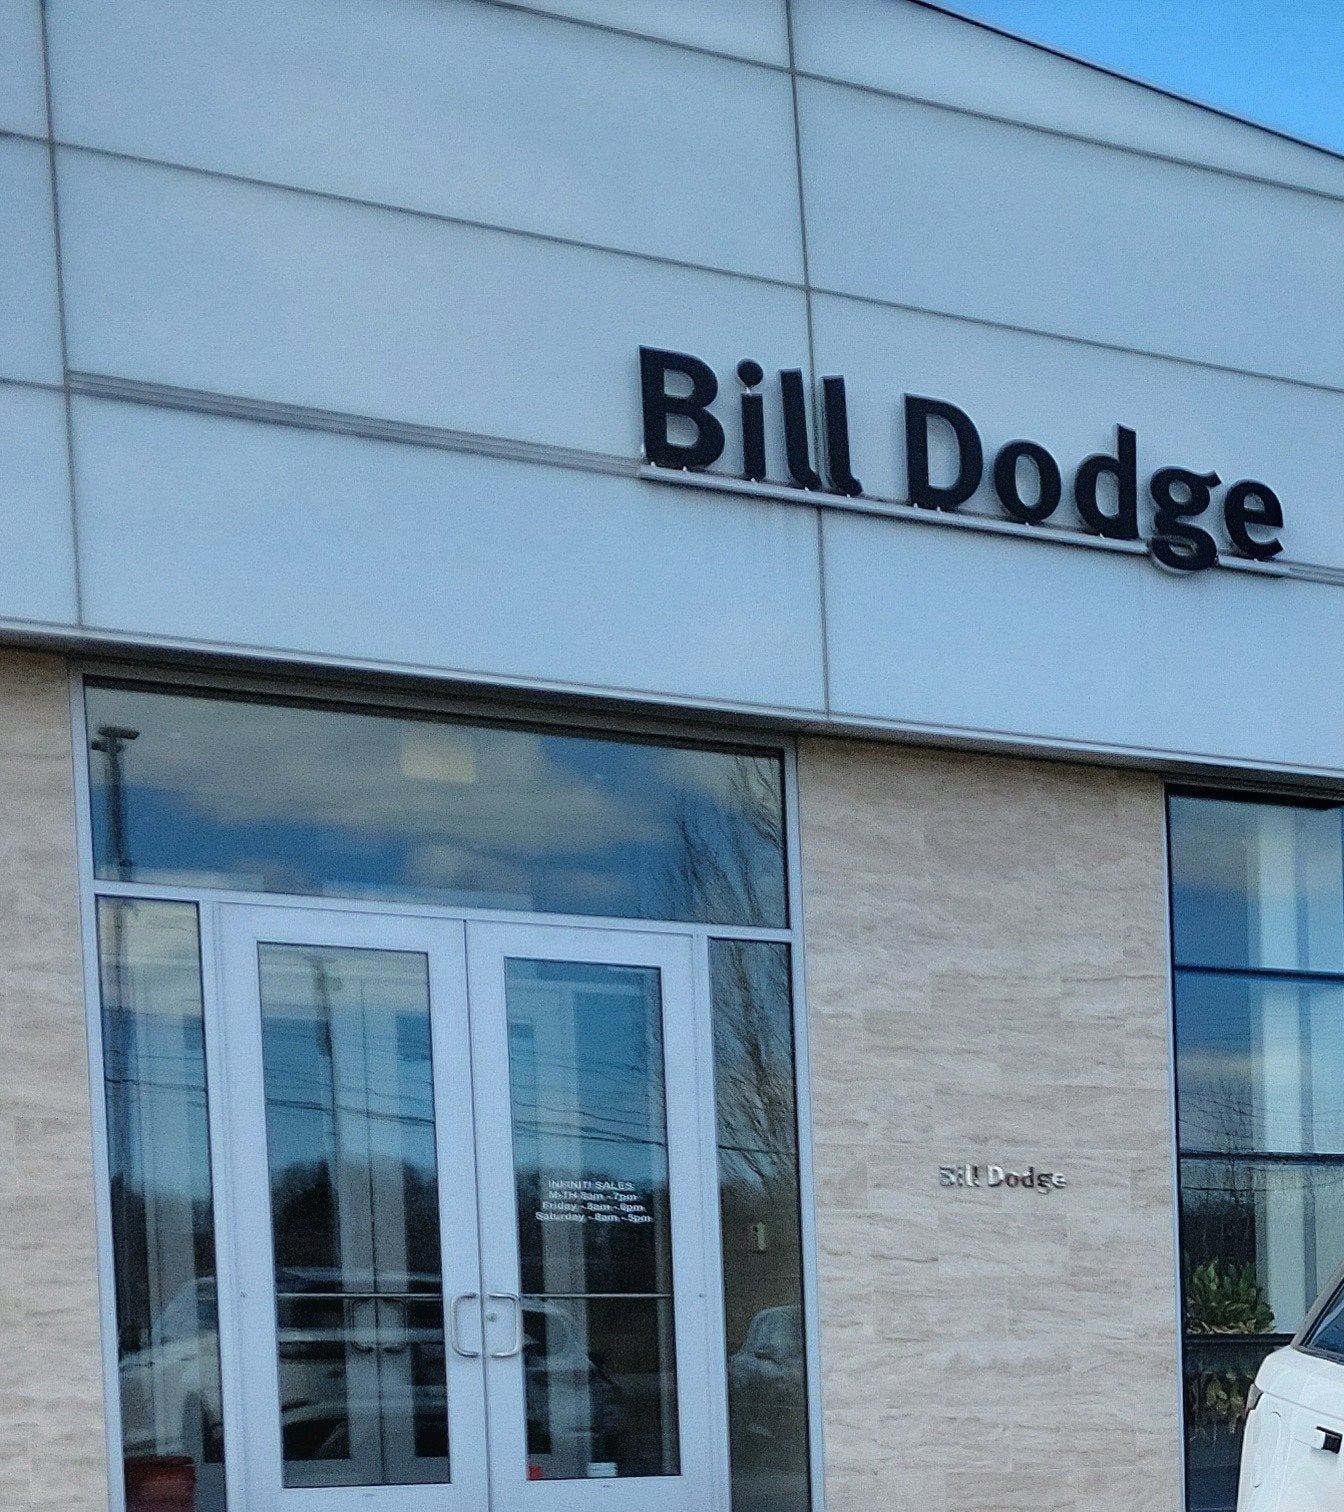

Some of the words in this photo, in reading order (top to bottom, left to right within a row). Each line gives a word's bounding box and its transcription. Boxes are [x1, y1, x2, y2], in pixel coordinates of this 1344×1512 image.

[638, 344, 863, 496] Bill
[903, 392, 1285, 574] Dodge
[986, 1164, 1068, 1195] Dodge
[595, 1181, 636, 1191] SALES
[542, 1201, 578, 1211] Friday
[535, 1211, 586, 1223] Saturday
